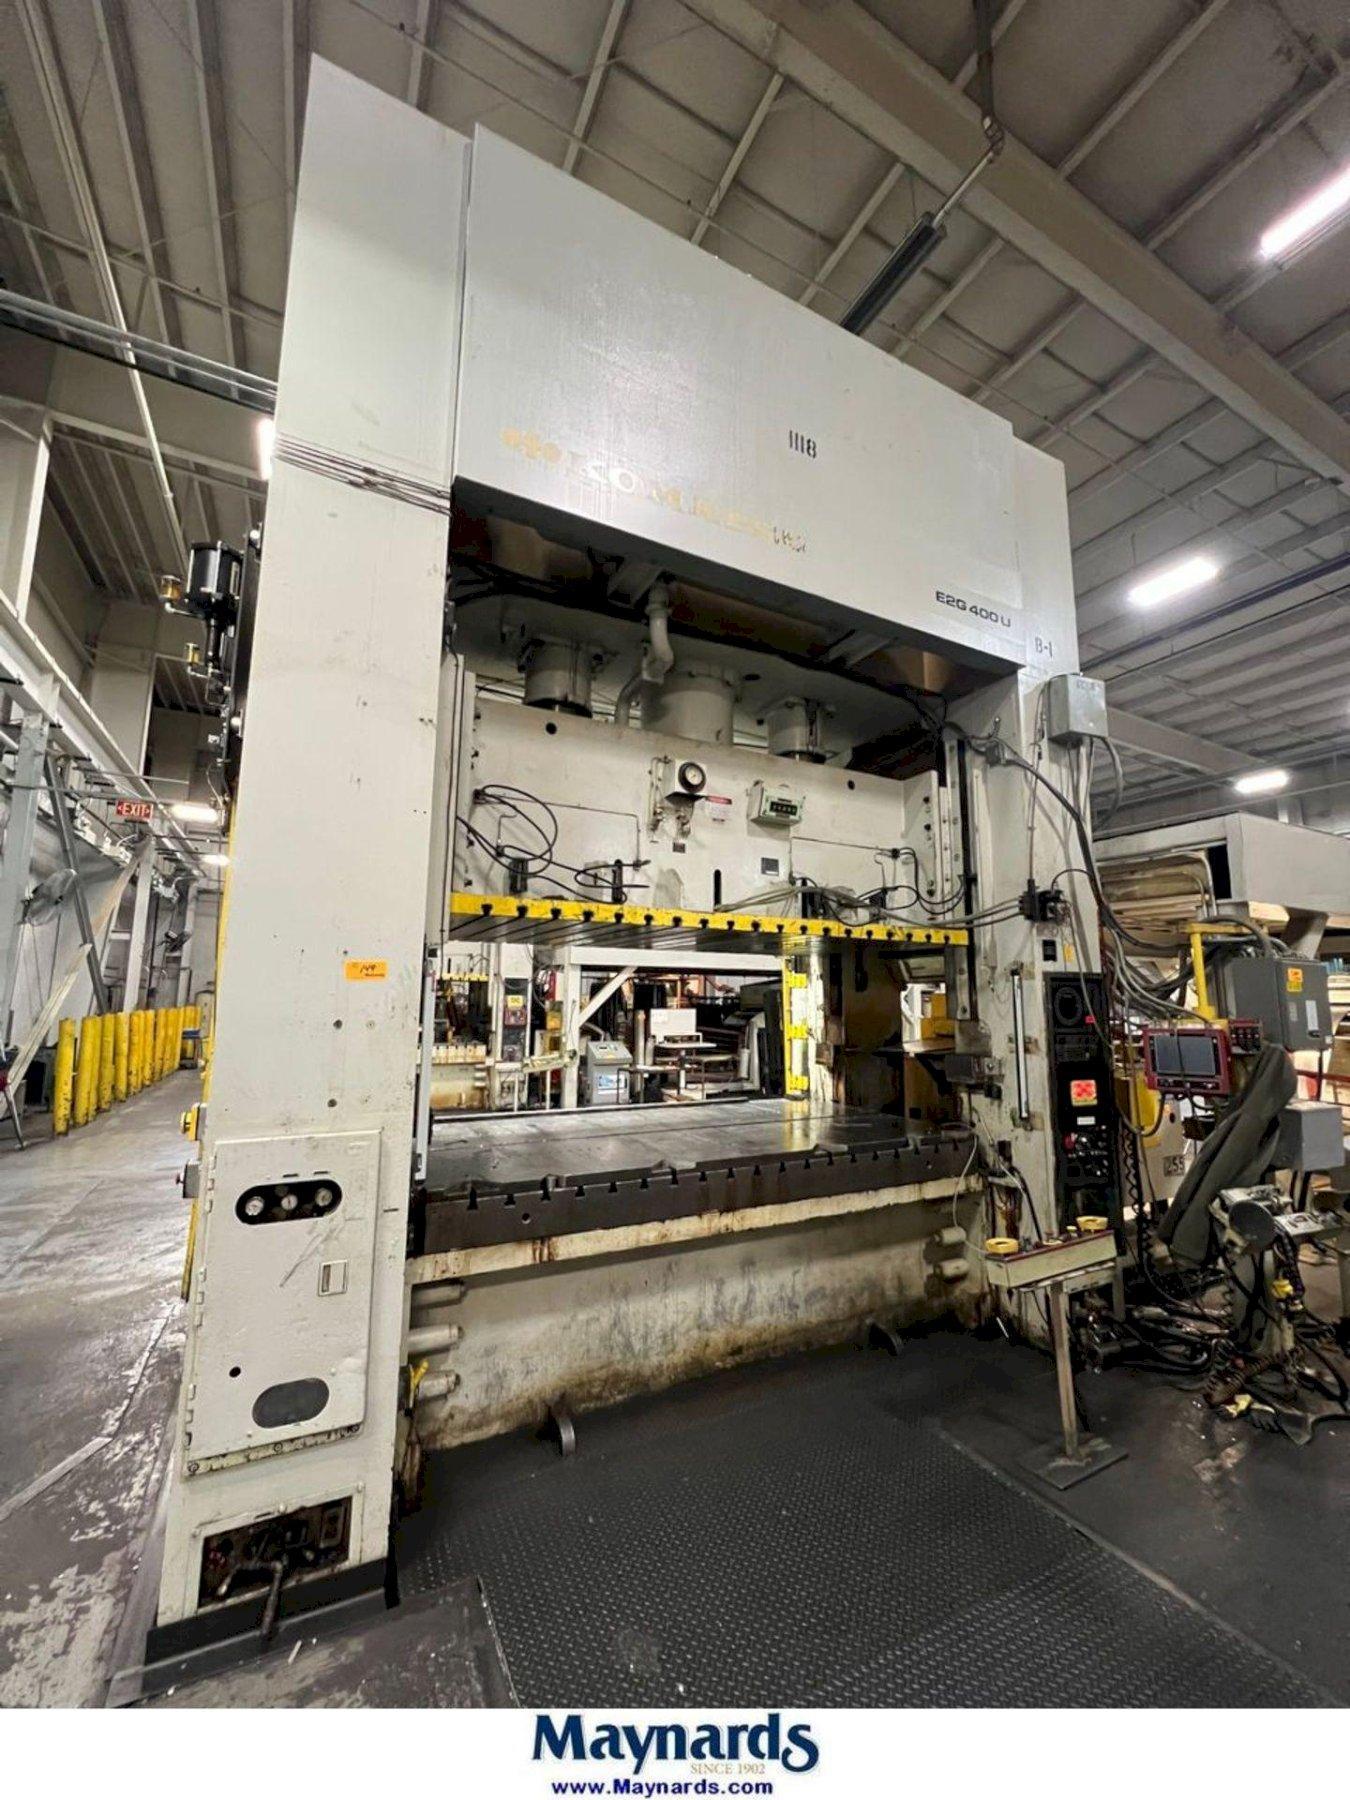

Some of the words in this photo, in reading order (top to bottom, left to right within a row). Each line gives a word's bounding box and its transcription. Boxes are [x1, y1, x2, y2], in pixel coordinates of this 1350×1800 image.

[936, 590, 967, 611] E2G
[969, 605, 999, 623] 400
[1000, 615, 1011, 628] U
[122, 802, 147, 817] EXIT
